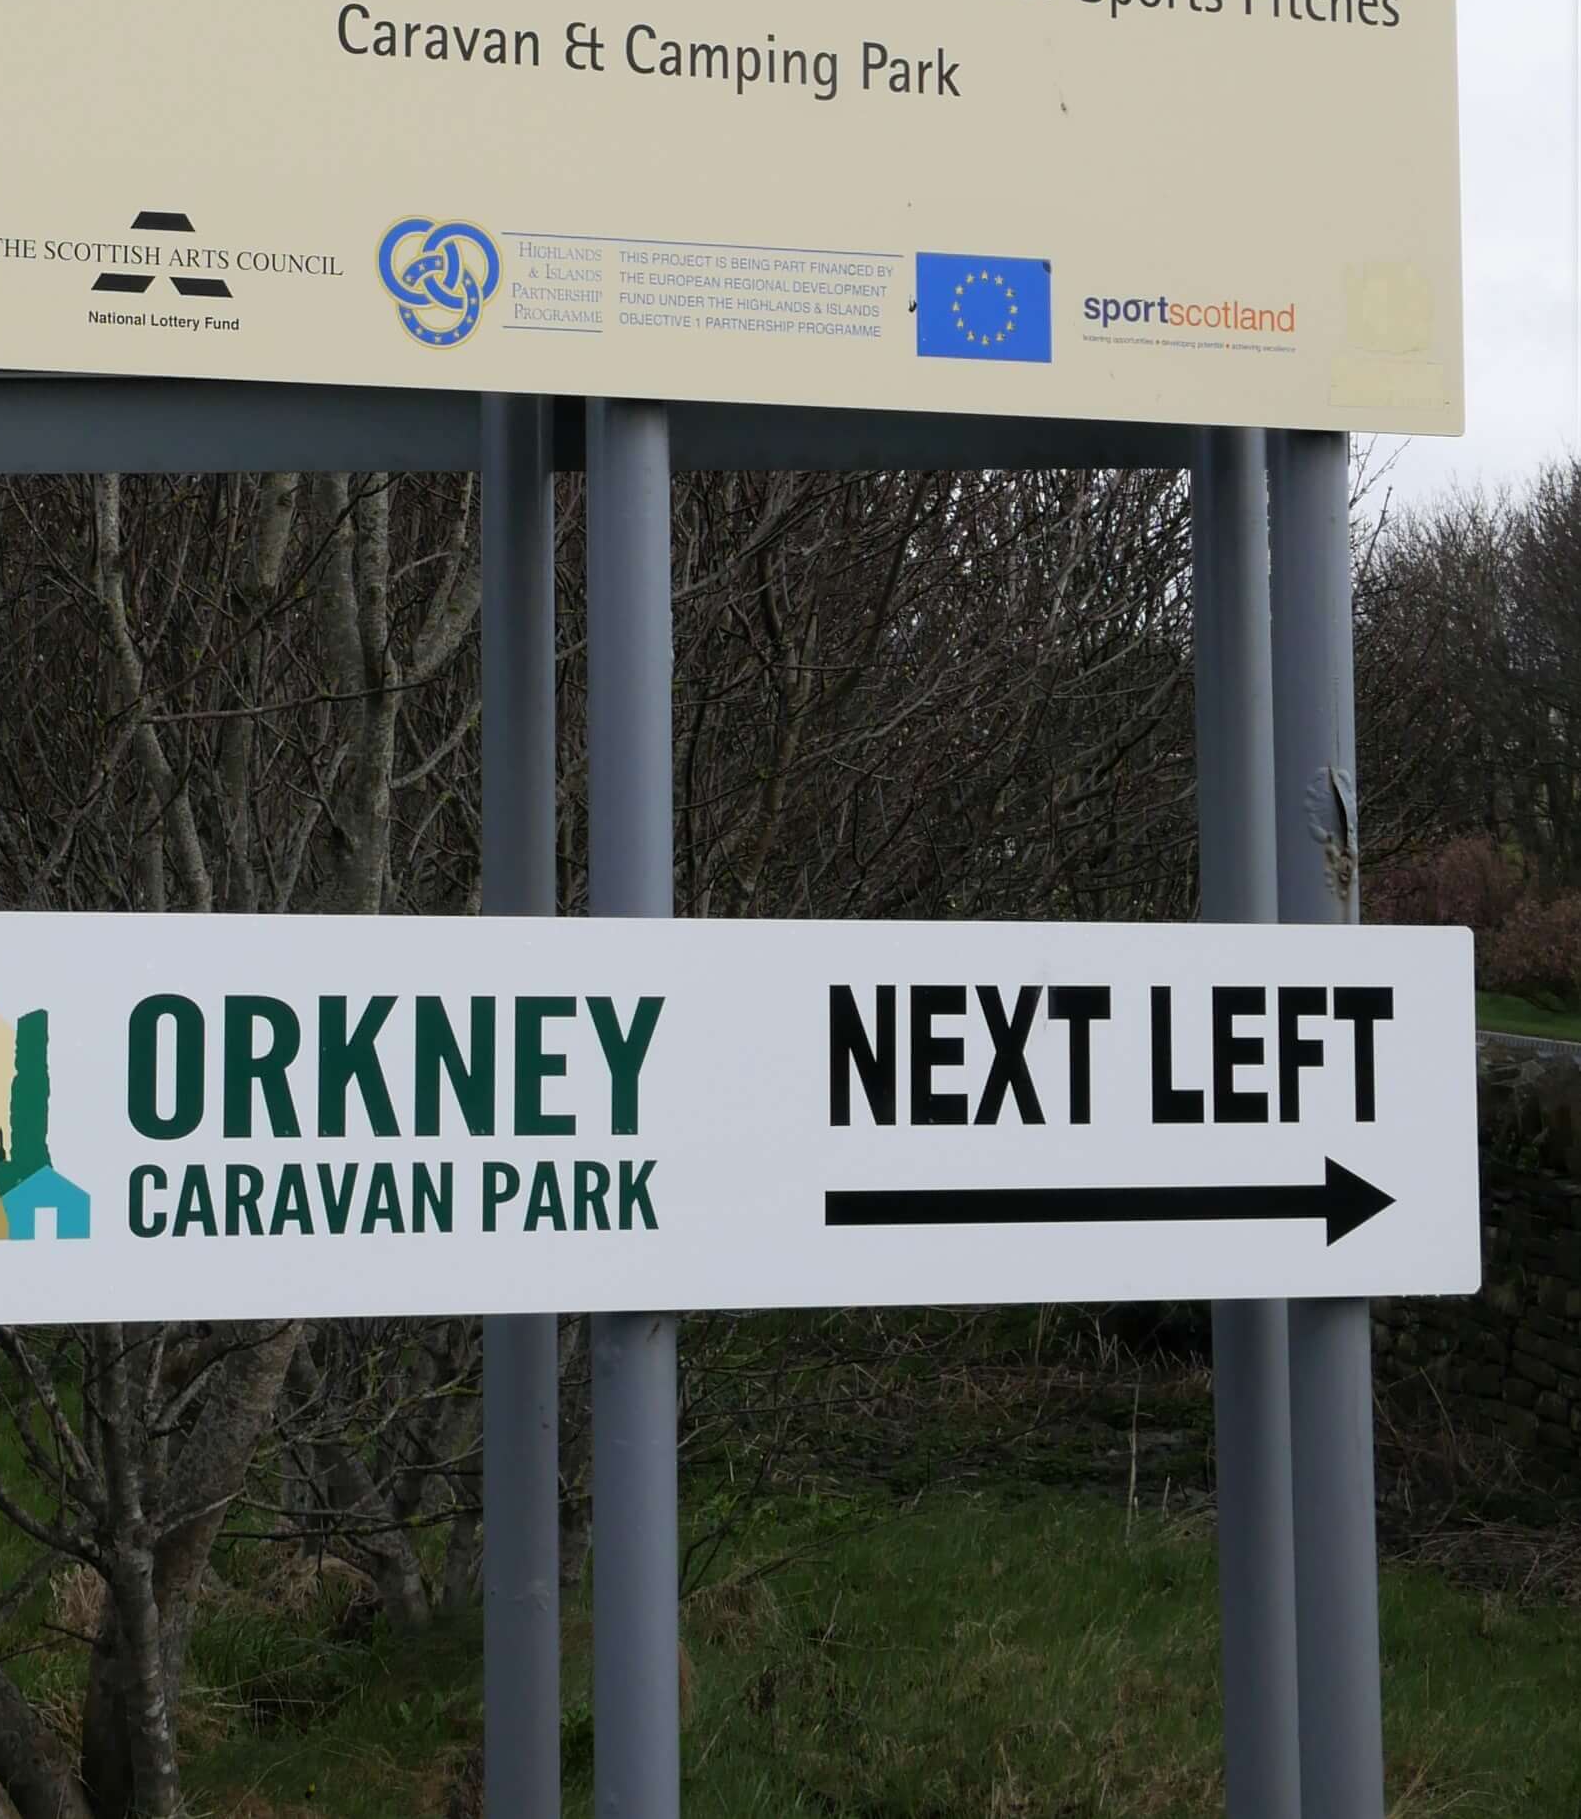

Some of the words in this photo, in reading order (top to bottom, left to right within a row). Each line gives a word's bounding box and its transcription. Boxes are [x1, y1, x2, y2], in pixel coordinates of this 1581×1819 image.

[337, 3, 540, 67] Caravan
[565, 21, 605, 72] &
[625, 24, 838, 101] Camping
[862, 41, 961, 97] Park
[44, 240, 160, 266] SCOTTISH
[168, 248, 229, 270] ARTS
[236, 251, 343, 276] COUNCIL
[619, 251, 649, 265] THIS
[652, 253, 713, 268] PROJECT
[716, 256, 727, 269] IS
[730, 257, 770, 271] BEING
[774, 260, 806, 273] PART
[810, 262, 874, 277] FINANCED
[877, 266, 894, 277] BY
[619, 271, 644, 285] THE
[649, 273, 721, 287] EUROPEAN
[724, 277, 790, 292] REGIONAL
[793, 281, 887, 297] DEVELOPMENT
[88, 310, 146, 326] National
[150, 313, 200, 332] Lottery
[204, 316, 240, 331] Fund
[619, 292, 655, 305] FUND
[659, 294, 705, 308] UNDER
[708, 296, 733, 309] THE
[737, 298, 811, 314] HIGHLANDS
[813, 303, 822, 314] &
[826, 302, 880, 317] ISLANDS
[1083, 295, 1295, 333] sportscotland
[619, 312, 691, 328] OBJECTIVE
[705, 317, 794, 333] PARTNERSHIP
[798, 322, 881, 337] PROGRAMME
[127, 993, 666, 1141] ORKNEY
[829, 984, 1112, 1127] NEXT
[1150, 985, 1394, 1125] LEFT
[128, 1161, 454, 1239] CARAVAN
[482, 1159, 660, 1233] PARK
